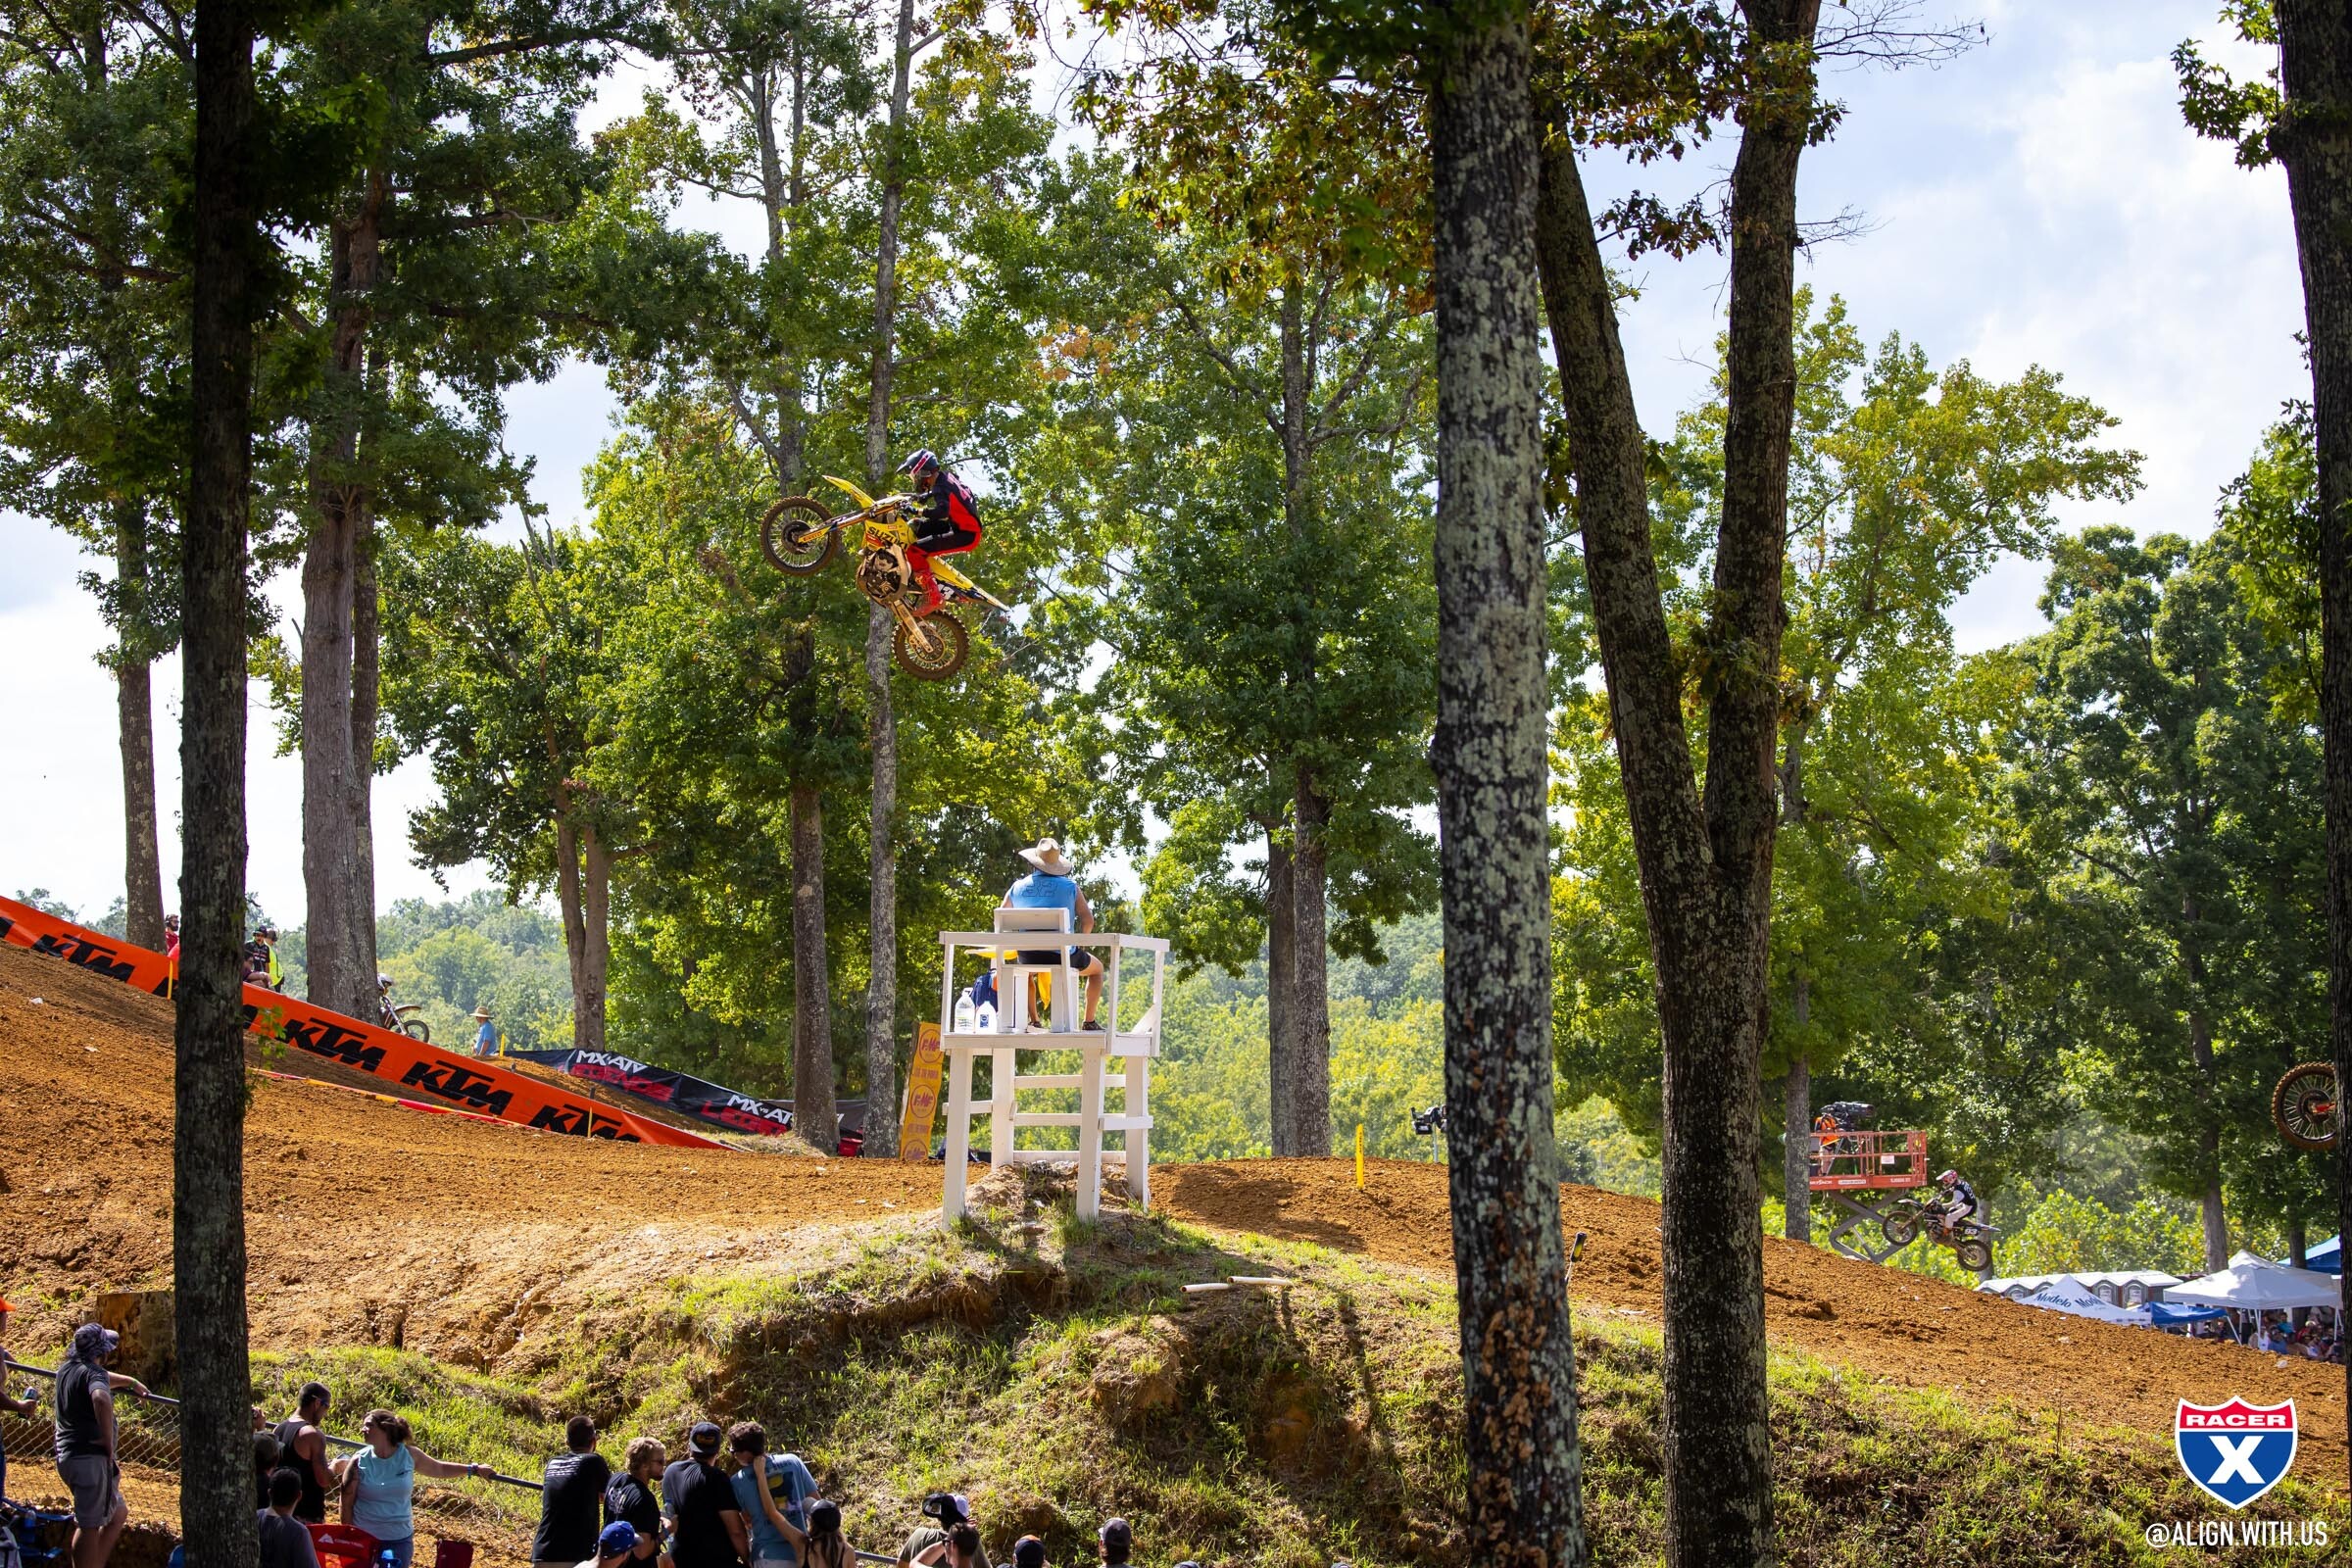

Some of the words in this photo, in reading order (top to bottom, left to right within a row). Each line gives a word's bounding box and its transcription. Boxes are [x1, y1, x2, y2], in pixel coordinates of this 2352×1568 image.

[31, 933, 135, 983] KTM
[274, 1017, 387, 1072] KTM
[400, 1059, 514, 1115] KTM
[727, 1095, 763, 1115] MX
[764, 1108, 794, 1125] AT
[2034, 1294, 2072, 1308] Modelo
